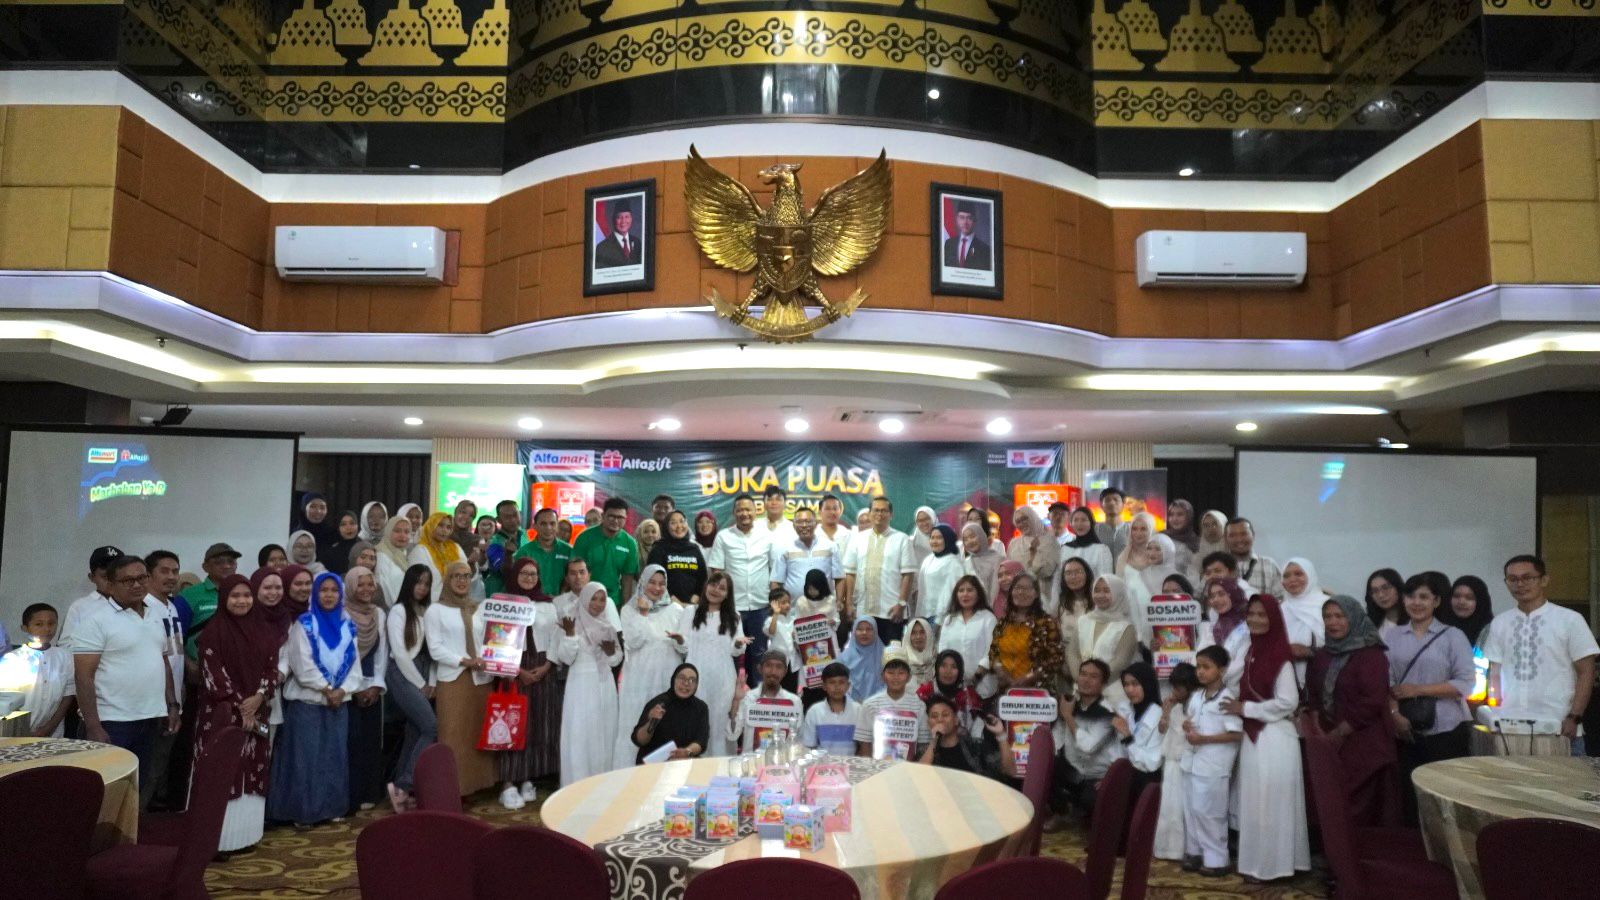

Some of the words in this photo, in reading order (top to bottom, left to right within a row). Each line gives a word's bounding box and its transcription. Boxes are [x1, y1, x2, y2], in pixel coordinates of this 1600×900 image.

[623, 457, 672, 471] Alfagift
[700, 465, 780, 496] BUKA
[788, 465, 884, 497] PUASA
[485, 602, 533, 615] BOSAN?
[1147, 604, 1196, 615] BOSAN?
